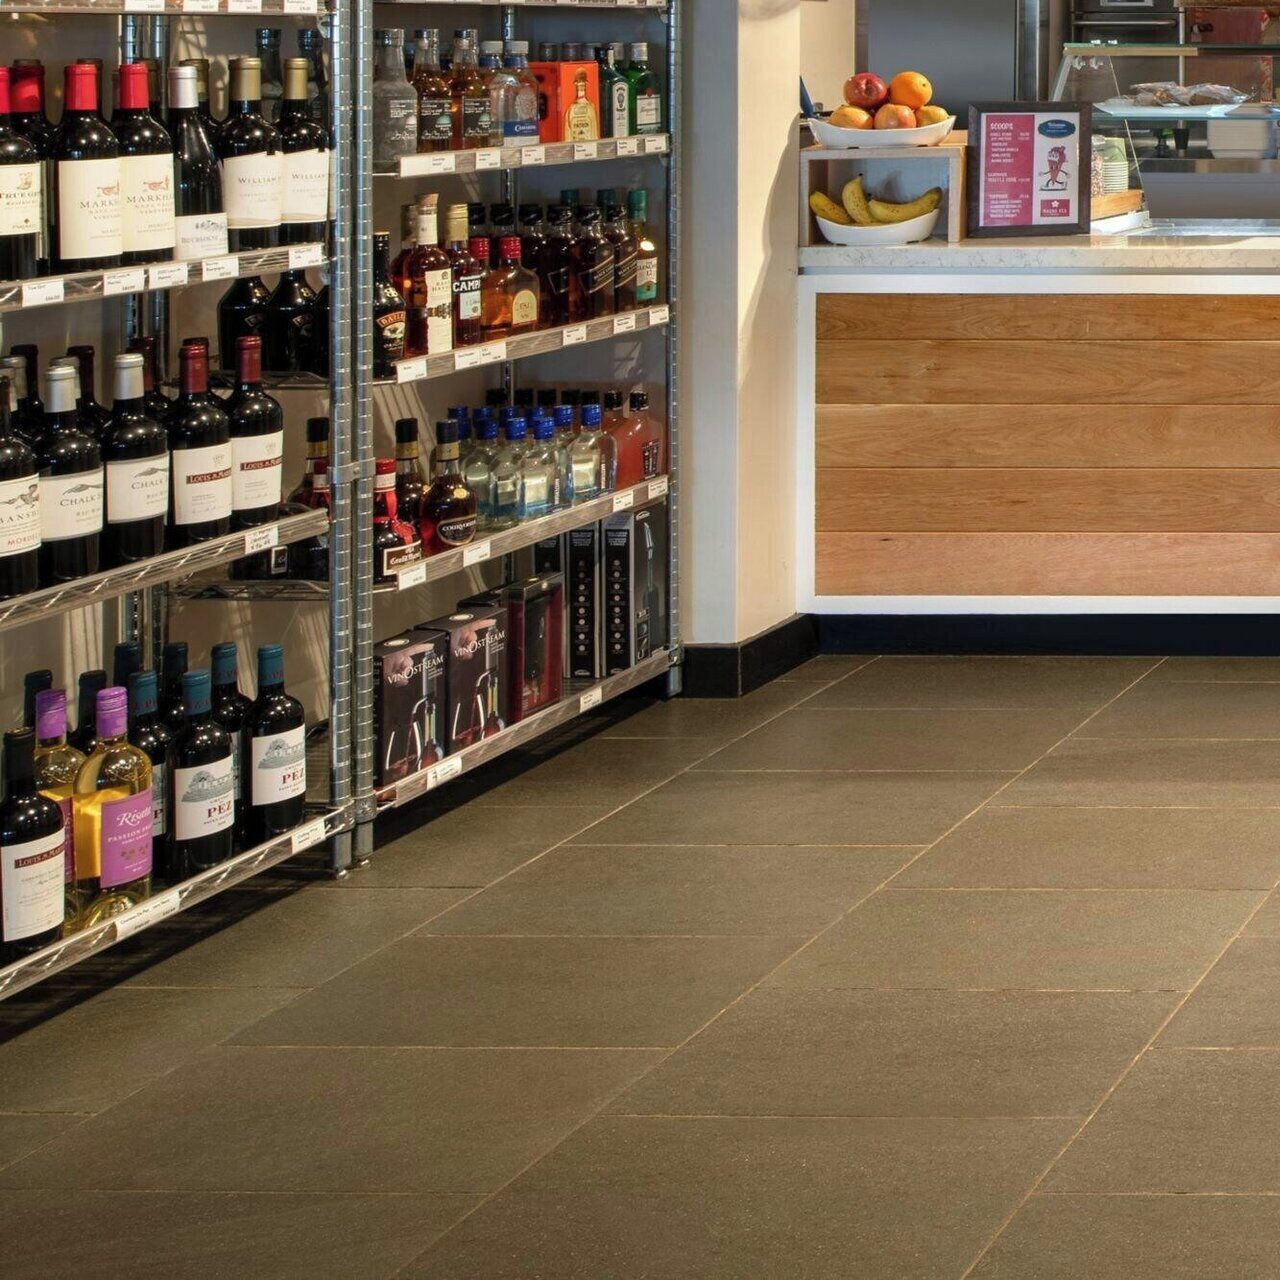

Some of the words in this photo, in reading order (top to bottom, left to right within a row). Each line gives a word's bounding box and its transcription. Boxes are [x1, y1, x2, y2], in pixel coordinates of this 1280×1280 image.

[454, 631, 505, 658] VINOSTREAM
[387, 654, 444, 684] VINOSTREAM
[282, 769, 305, 784] PEZ
[207, 801, 232, 818] PEZ
